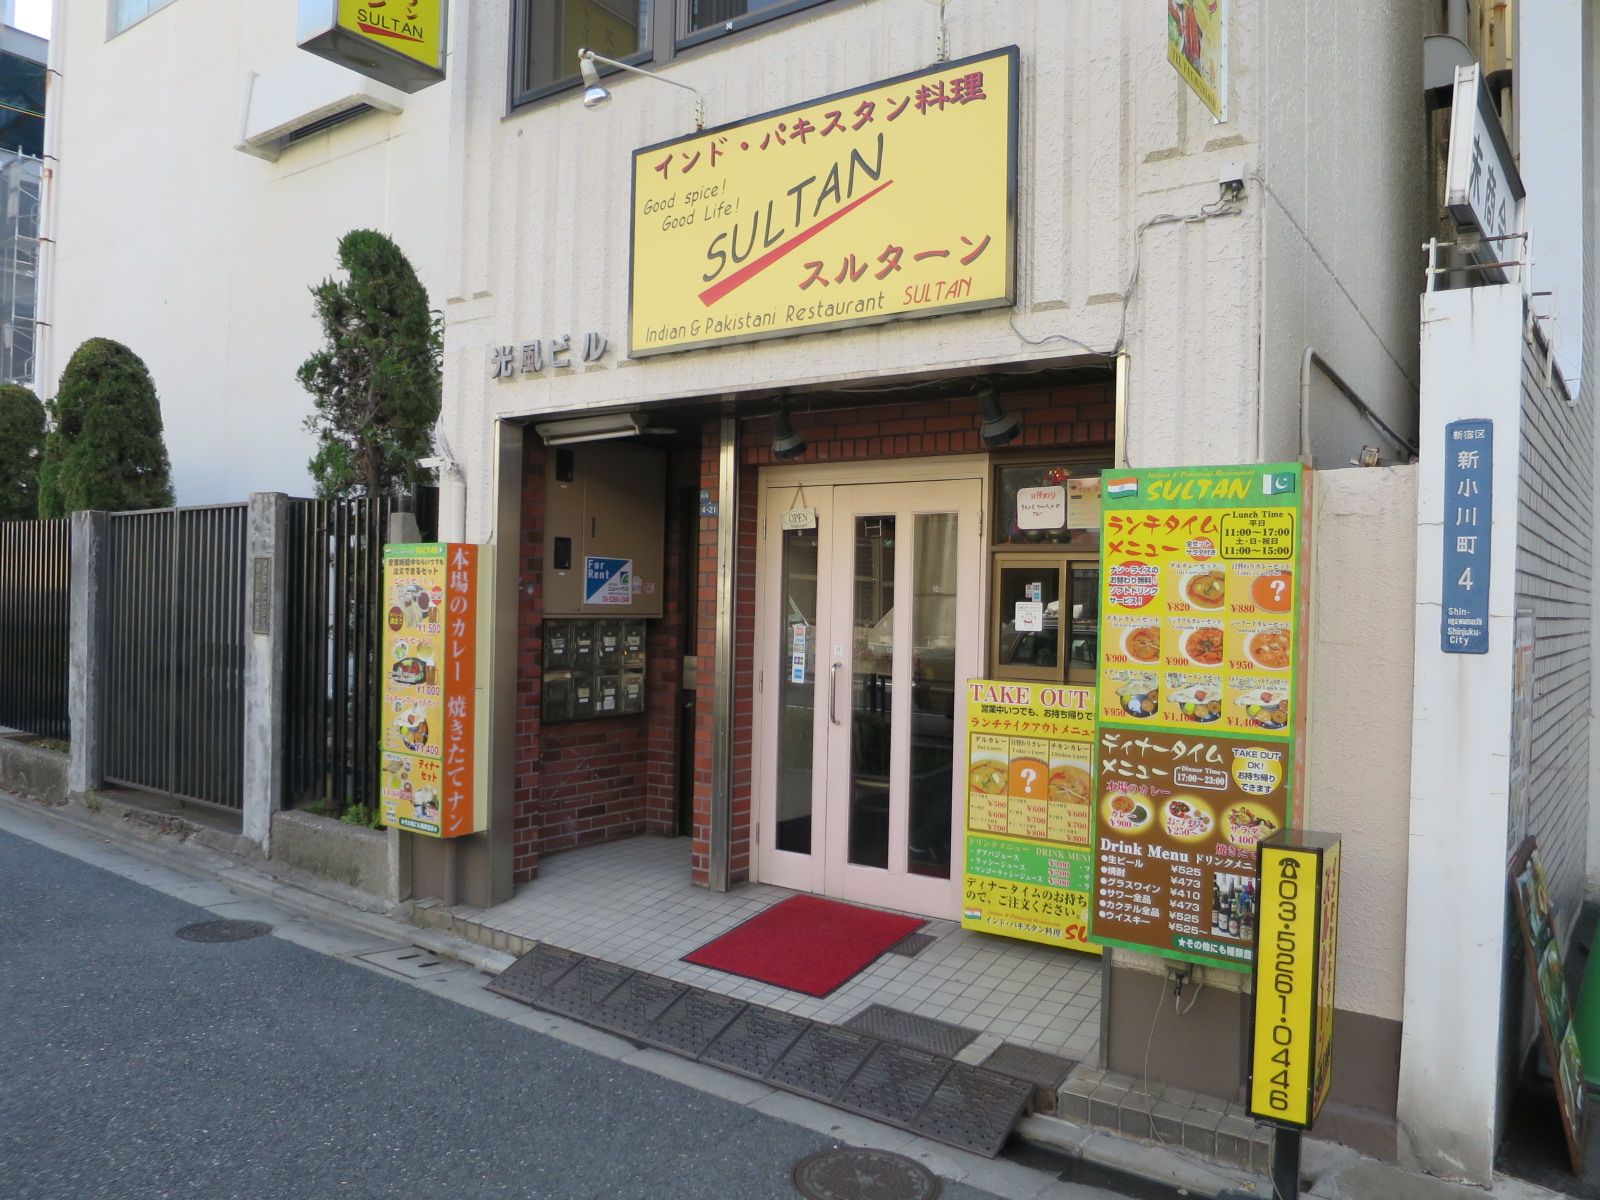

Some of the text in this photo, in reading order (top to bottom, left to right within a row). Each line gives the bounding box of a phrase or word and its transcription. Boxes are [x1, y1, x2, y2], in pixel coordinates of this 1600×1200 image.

[357, 8, 423, 39] SULTAN
[654, 71, 987, 180] インド・パキスタン料理
[643, 179, 726, 217] Good spice!
[702, 132, 884, 282] SULTAN
[661, 197, 740, 233] Good Life!
[798, 234, 991, 291] スルターン
[645, 276, 972, 343] Indian & Pakistani Restaurant SULTAN
[491, 332, 609, 380] 光風ビル
[1452, 429, 1486, 440] 新宿区
[1146, 478, 1252, 501] SULTAN
[788, 512, 808, 523] OPEN
[1232, 510, 1284, 519] Lunch Time
[1108, 515, 1219, 535] ランチタイム
[1108, 540, 1180, 558] メニュー
[588, 559, 605, 570] For
[588, 569, 610, 580] Rent
[1166, 602, 1190, 612] ¥820
[1229, 604, 1254, 613] ¥880
[448, 549, 470, 682] 本場のカレー
[1449, 635, 1469, 646] City
[1104, 653, 1127, 664] ¥900
[1165, 656, 1189, 667] ¥900
[1228, 660, 1253, 670] ¥950
[970, 684, 1089, 709] TAKE OUT
[980, 704, 1096, 721] 営業中いつでも、お持ち帰りで
[1103, 706, 1127, 717] ¥950
[971, 717, 1058, 733] ランチテイクアウト
[975, 736, 1007, 744] ダルカレー
[1051, 742, 1089, 753] チキンカレー
[1102, 733, 1224, 764] ディナータイム
[1233, 749, 1281, 760] TAKE OUT
[446, 695, 468, 833] 焼きたてナン
[1102, 758, 1169, 780] メニュー
[1247, 761, 1264, 770] OK!
[421, 772, 437, 782] セット
[1204, 768, 1221, 776] Time
[1238, 771, 1276, 783] お持ち帰り
[1241, 783, 1272, 793] できます
[987, 811, 1006, 820] ¥600
[1026, 816, 1046, 825] ¥700
[1066, 821, 1086, 830] ¥700
[1035, 847, 1065, 859] DRINK
[1100, 837, 1189, 862] Drink Menu
[1108, 854, 1144, 869] 生ビール
[1195, 853, 1257, 871] ドリンクメニ
[1170, 864, 1202, 877] ¥525
[1107, 877, 1161, 893] グラスワイン
[1170, 876, 1201, 889] ¥473
[966, 877, 1088, 908] ディナータイムのお持ち
[1106, 889, 1152, 905] サワー全品
[1169, 887, 1201, 900] ¥410
[1106, 900, 1160, 917] カクテル全品
[1169, 899, 1200, 911] ¥473
[1105, 911, 1151, 925] ウイスキー
[1168, 910, 1200, 923] ¥525
